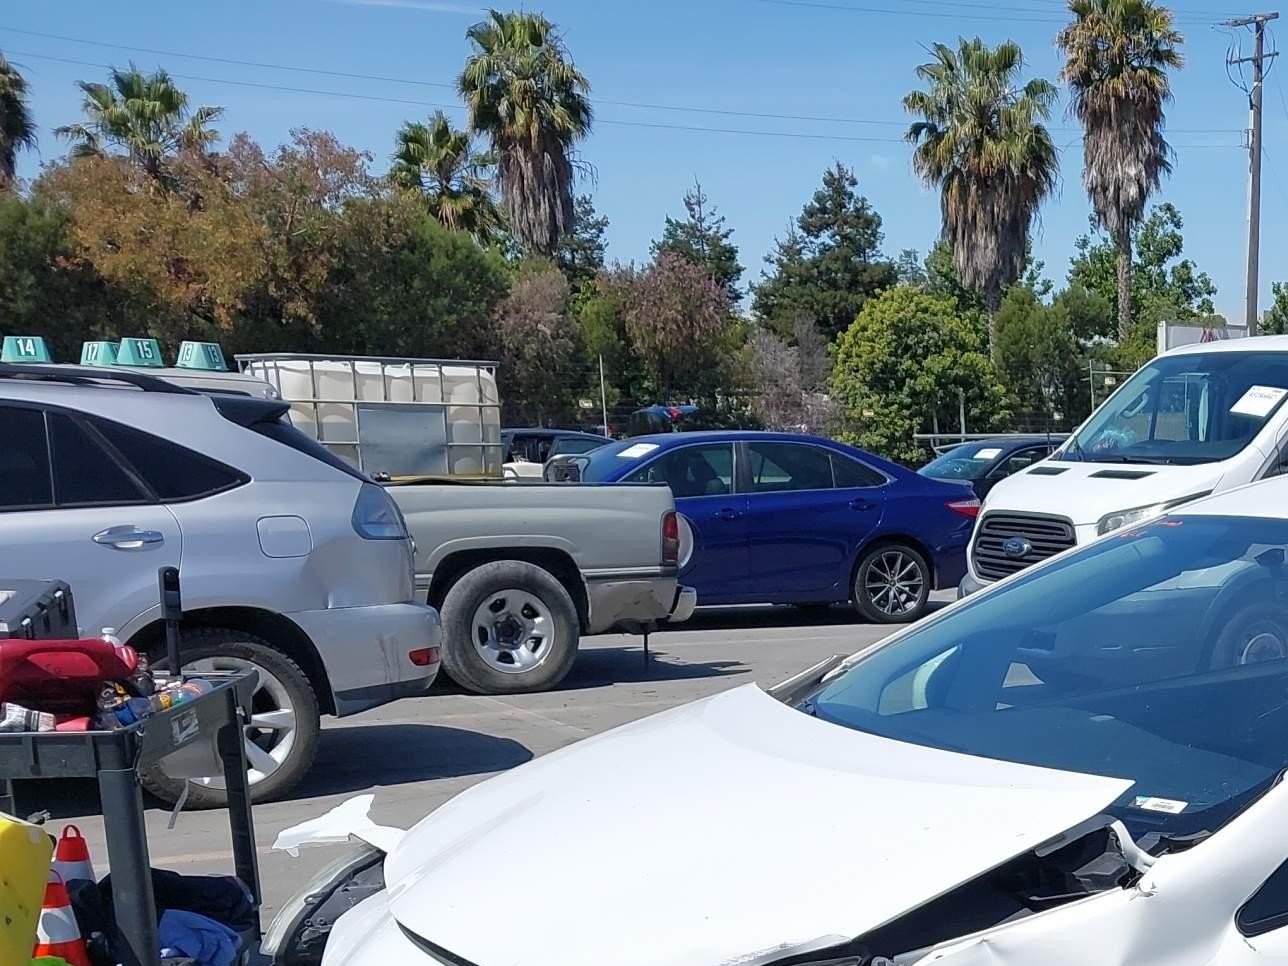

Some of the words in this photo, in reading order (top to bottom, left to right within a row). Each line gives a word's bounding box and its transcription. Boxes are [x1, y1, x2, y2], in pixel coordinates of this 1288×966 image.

[16, 338, 36, 356] 14
[87, 343, 98, 361] 17
[136, 340, 152, 360] 15
[183, 344, 193, 361] 13
[207, 344, 220, 363] 13
